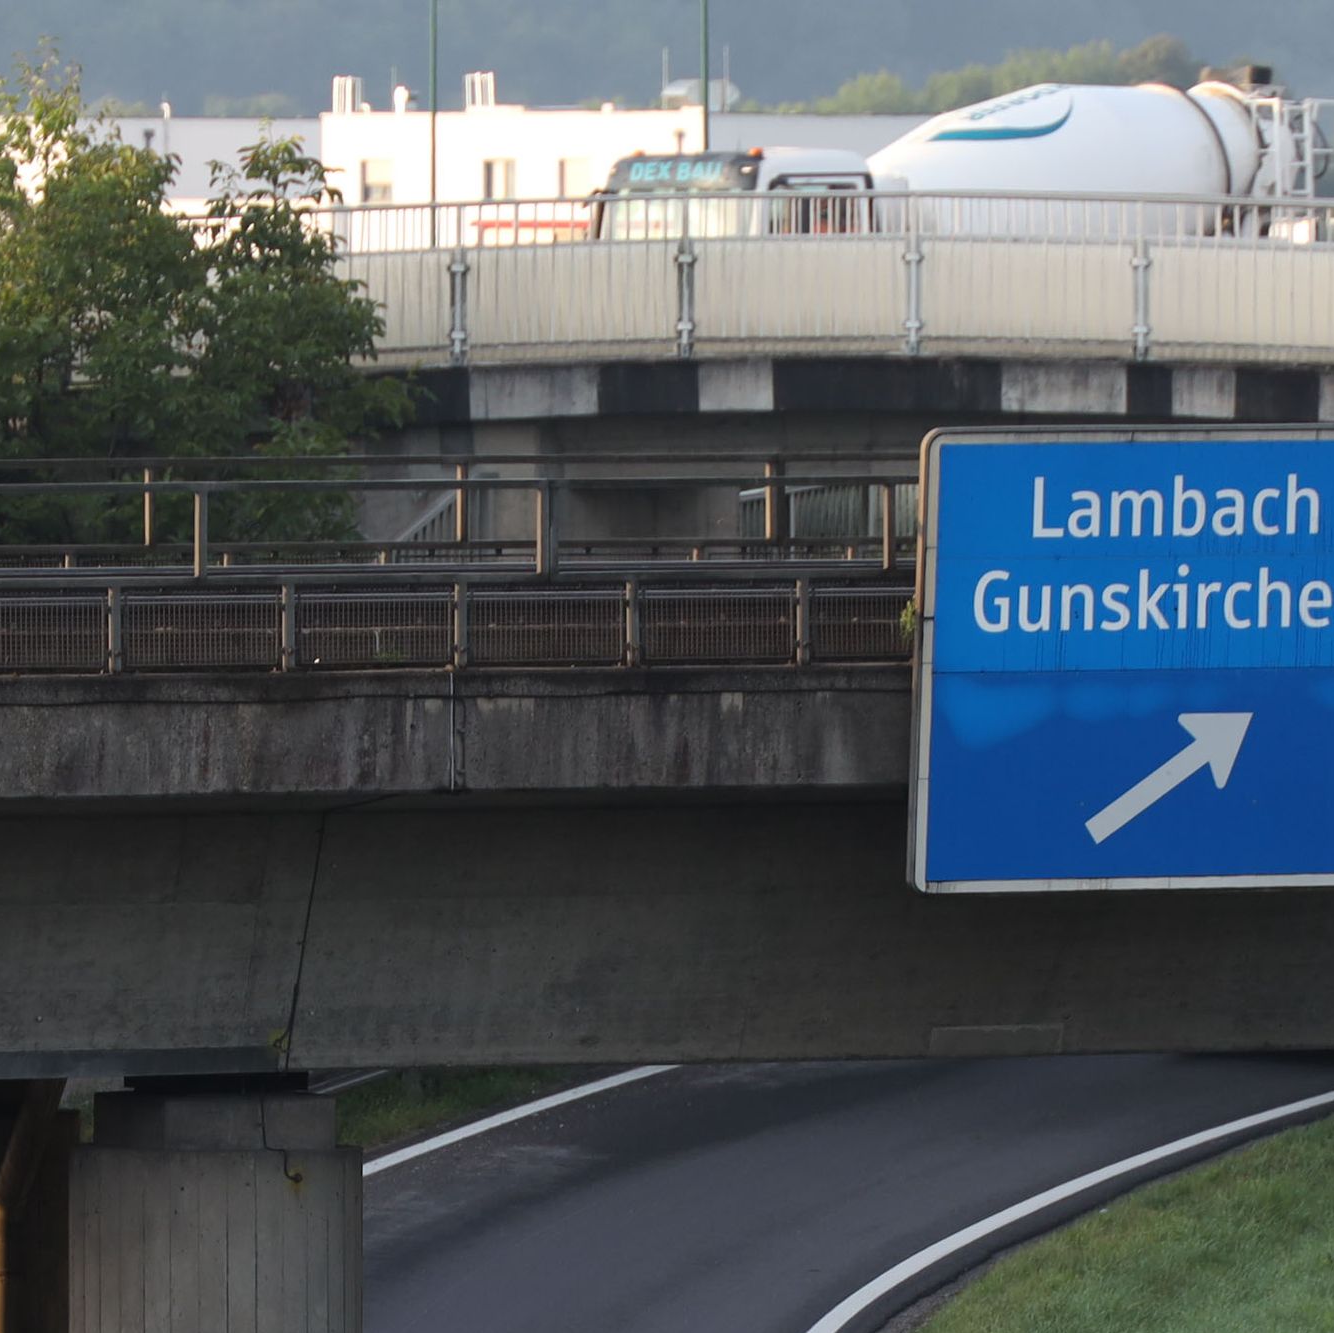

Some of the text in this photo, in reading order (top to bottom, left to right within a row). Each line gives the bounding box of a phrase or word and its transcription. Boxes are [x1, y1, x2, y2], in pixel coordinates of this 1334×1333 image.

[629, 159, 723, 181] DEX BAU
[1032, 473, 1320, 538] Lambach
